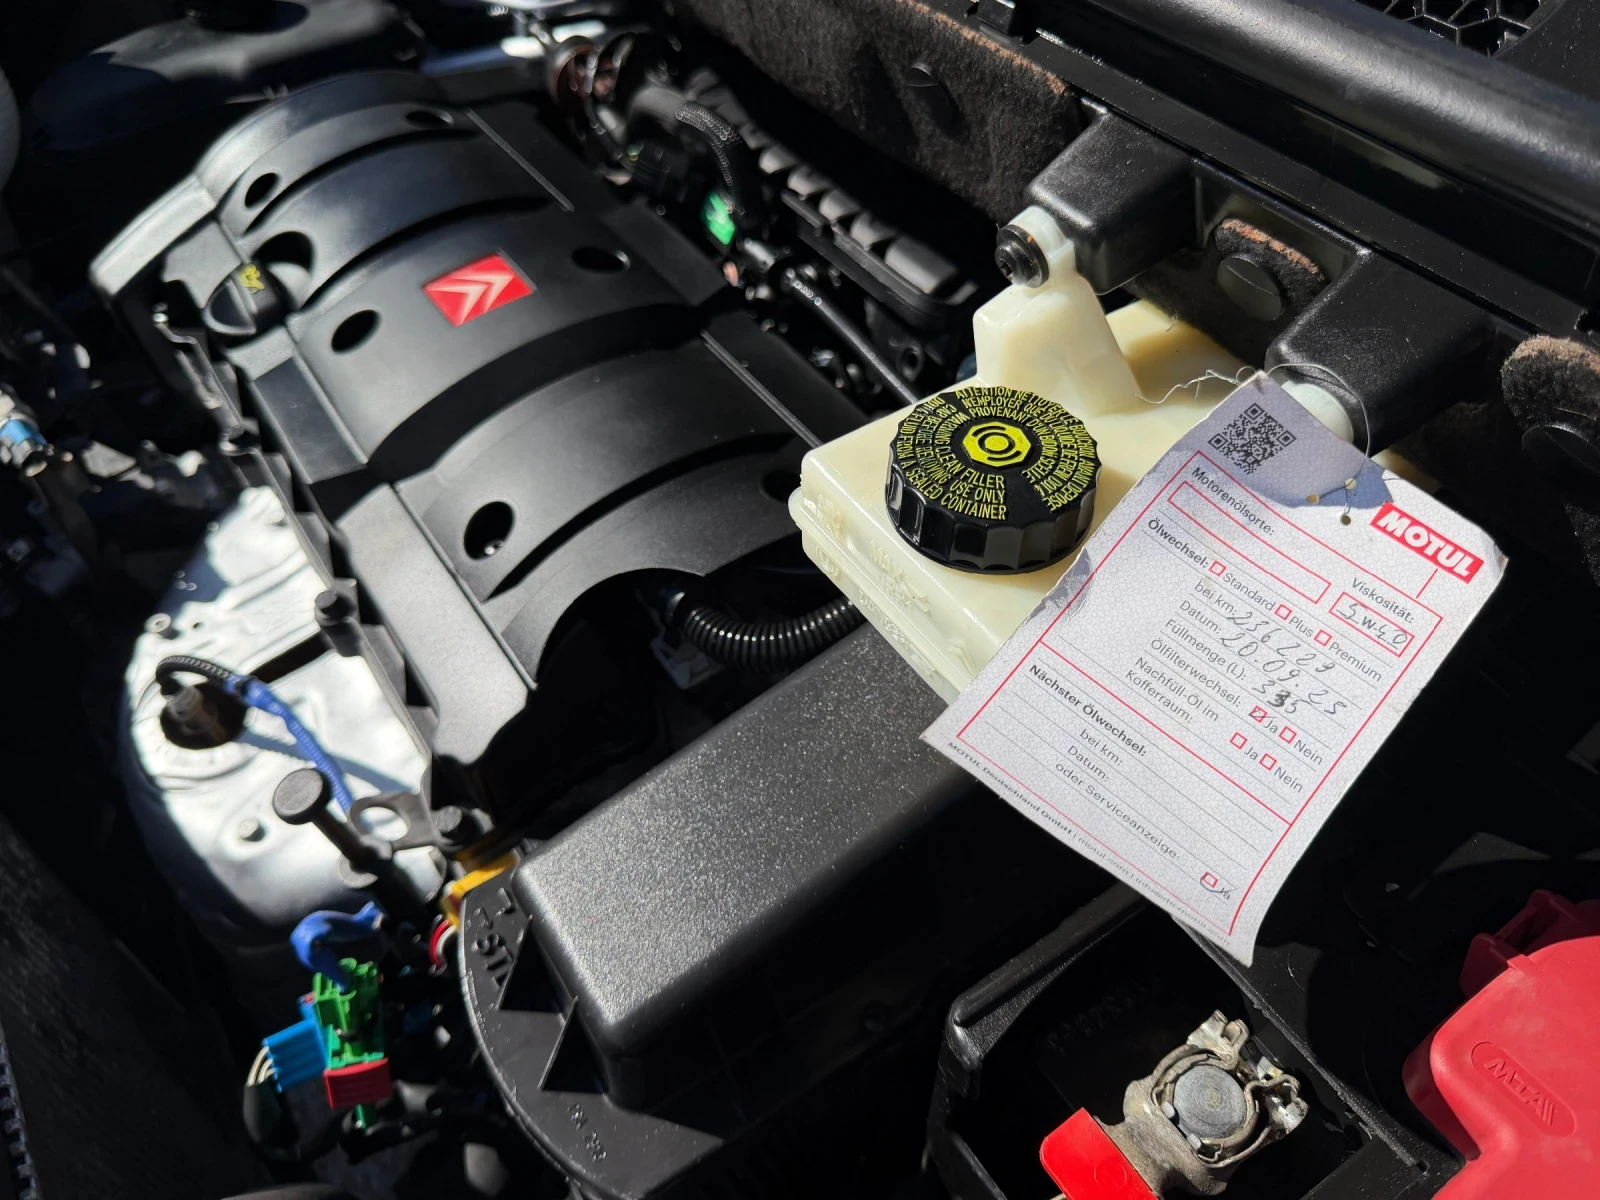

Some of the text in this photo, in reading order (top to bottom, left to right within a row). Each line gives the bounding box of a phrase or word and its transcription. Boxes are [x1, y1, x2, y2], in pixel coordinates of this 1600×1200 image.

[900, 413, 925, 434] FLUID
[1023, 403, 1044, 417] QUE
[1040, 412, 1058, 423] DU
[896, 435, 914, 459] FROM
[935, 412, 1005, 489] WARNING CLEAN FILLER
[955, 387, 1096, 511] ATTENTION NETTOYER LE BOUCHON AVANT DEPOSE
[969, 406, 1031, 423] PROVENANT
[1040, 435, 1058, 457] BIDON
[1049, 421, 1077, 448] LIQUIDE
[900, 460, 917, 469] A
[915, 404, 1005, 504] CAP BEFORE REMOVING USE ONLY
[1053, 458, 1077, 481] FREIN
[1061, 449, 1078, 460] DE
[905, 467, 943, 499] SEALED
[1034, 484, 1045, 497] 4
[1041, 476, 1062, 493] DOT
[1191, 466, 1275, 536] Motorenölsorte:
[941, 493, 1007, 520] CONTAINER
[1376, 510, 1475, 577] MOTUL
[1147, 517, 1382, 682] Ölwechsel: Standard Plus Premium
[1178, 600, 1222, 634] Datum:
[1194, 580, 1238, 616] bei km:
[1351, 577, 1415, 624] Viskosität:
[1164, 618, 1247, 681] Füllmenge (L):
[1135, 656, 1219, 722] Nachfüll-Öl im
[1150, 637, 1323, 766] Ölfilterwechsel: Ja Nein
[1028, 663, 1147, 757] Nächster Ölwechsel:
[1079, 728, 1124, 766] bei km:
[1125, 669, 1303, 793] Kofferraum: Ja Nein
[1067, 745, 1109, 782] Datum:
[947, 742, 981, 768] MOTUL
[982, 767, 1041, 812] Deutschland
[1041, 810, 1073, 834] GmbH
[1055, 763, 1181, 860] oder Serviceanzeige:
